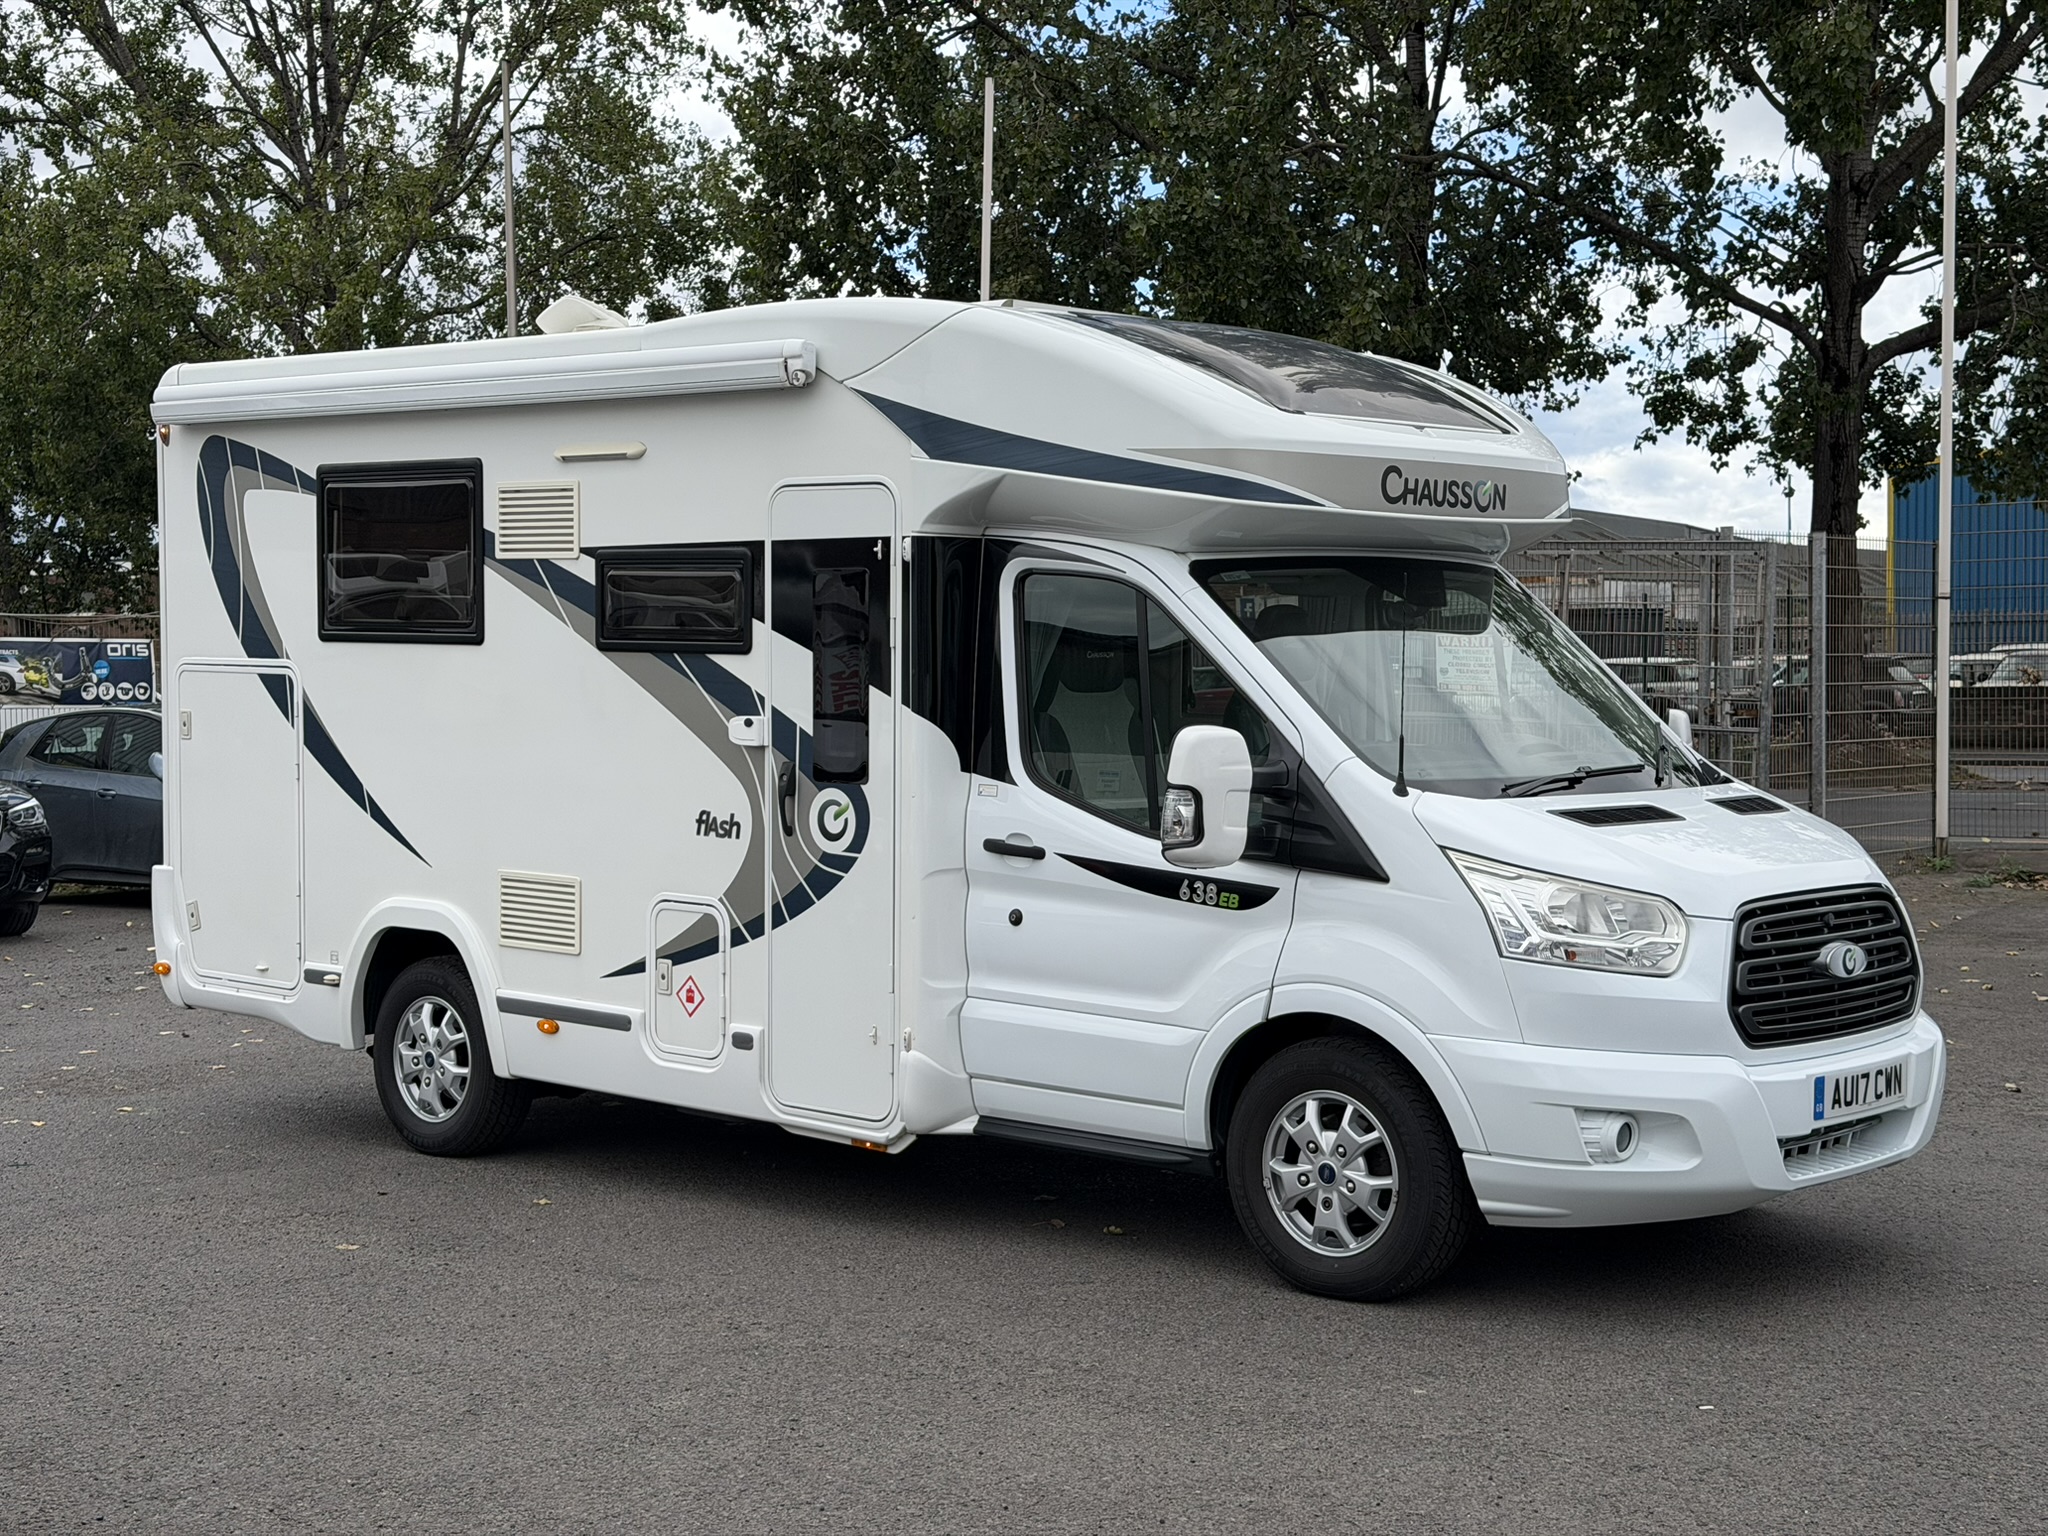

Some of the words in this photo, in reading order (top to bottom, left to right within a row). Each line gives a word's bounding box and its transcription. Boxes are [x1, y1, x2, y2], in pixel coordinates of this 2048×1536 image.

[1381, 465, 1507, 513] CHAUSSON
[1179, 878, 1218, 906] 638
[1219, 891, 1240, 909] EB
[1831, 1072, 1870, 1110] AU17
[1874, 1063, 1902, 1101] CWN
